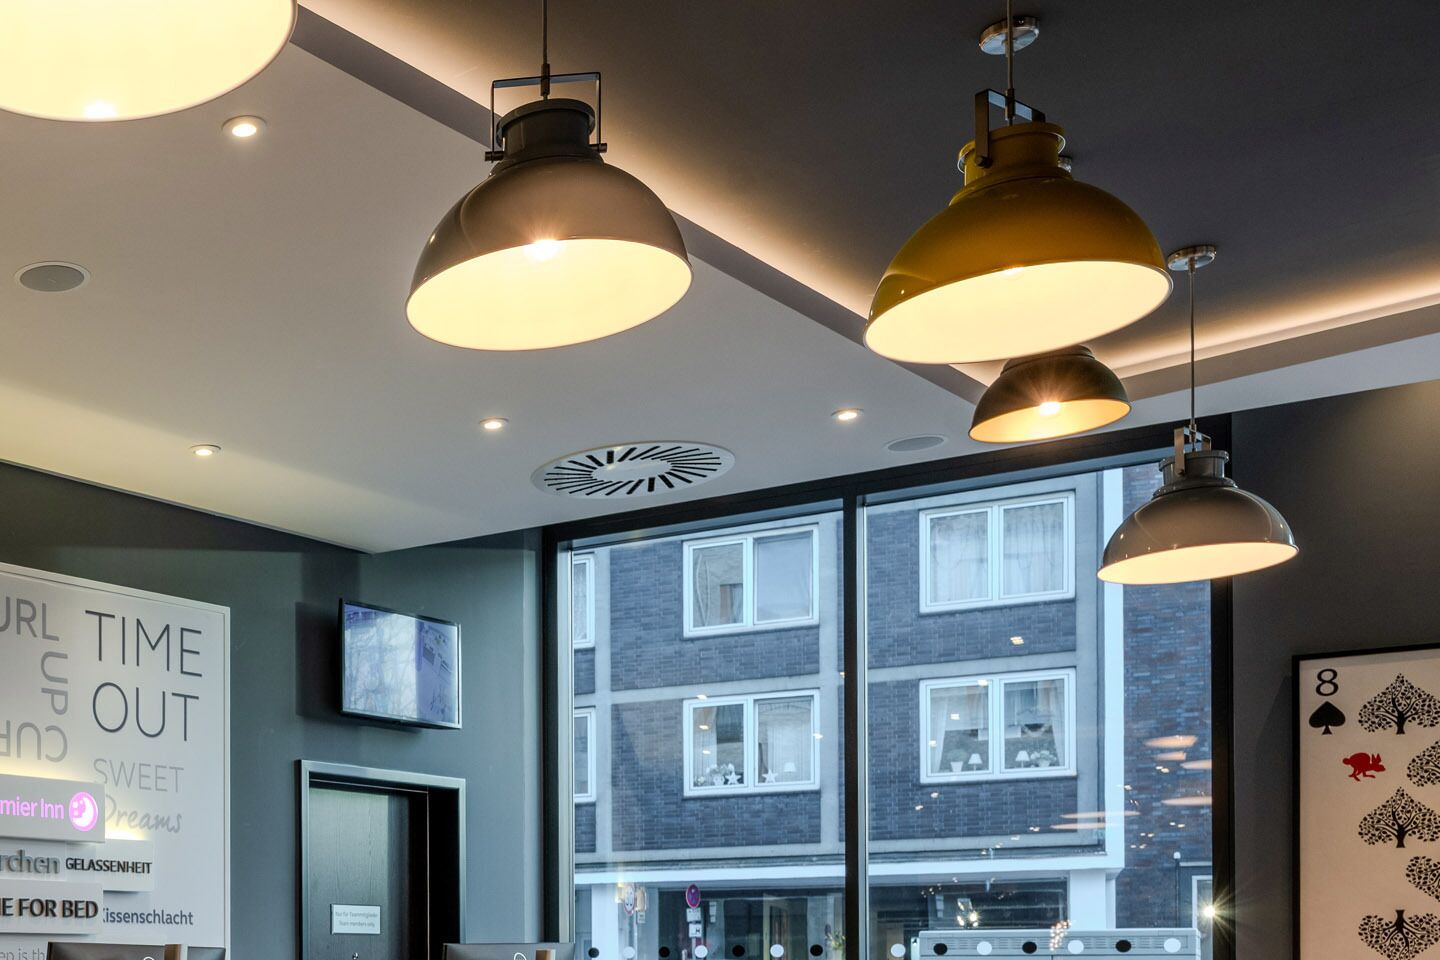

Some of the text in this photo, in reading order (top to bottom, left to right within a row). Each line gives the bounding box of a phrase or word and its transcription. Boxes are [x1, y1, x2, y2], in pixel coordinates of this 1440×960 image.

[85, 610, 202, 677] TIME
[40, 651, 69, 716] UP
[1315, 668, 1339, 696] 8
[92, 682, 199, 742] OUT
[93, 758, 184, 793] SWEET
[40, 798, 64, 819] Inn
[65, 857, 152, 874] GELASSENHEIT
[18, 898, 57, 918] FOR
[62, 900, 99, 919] BED
